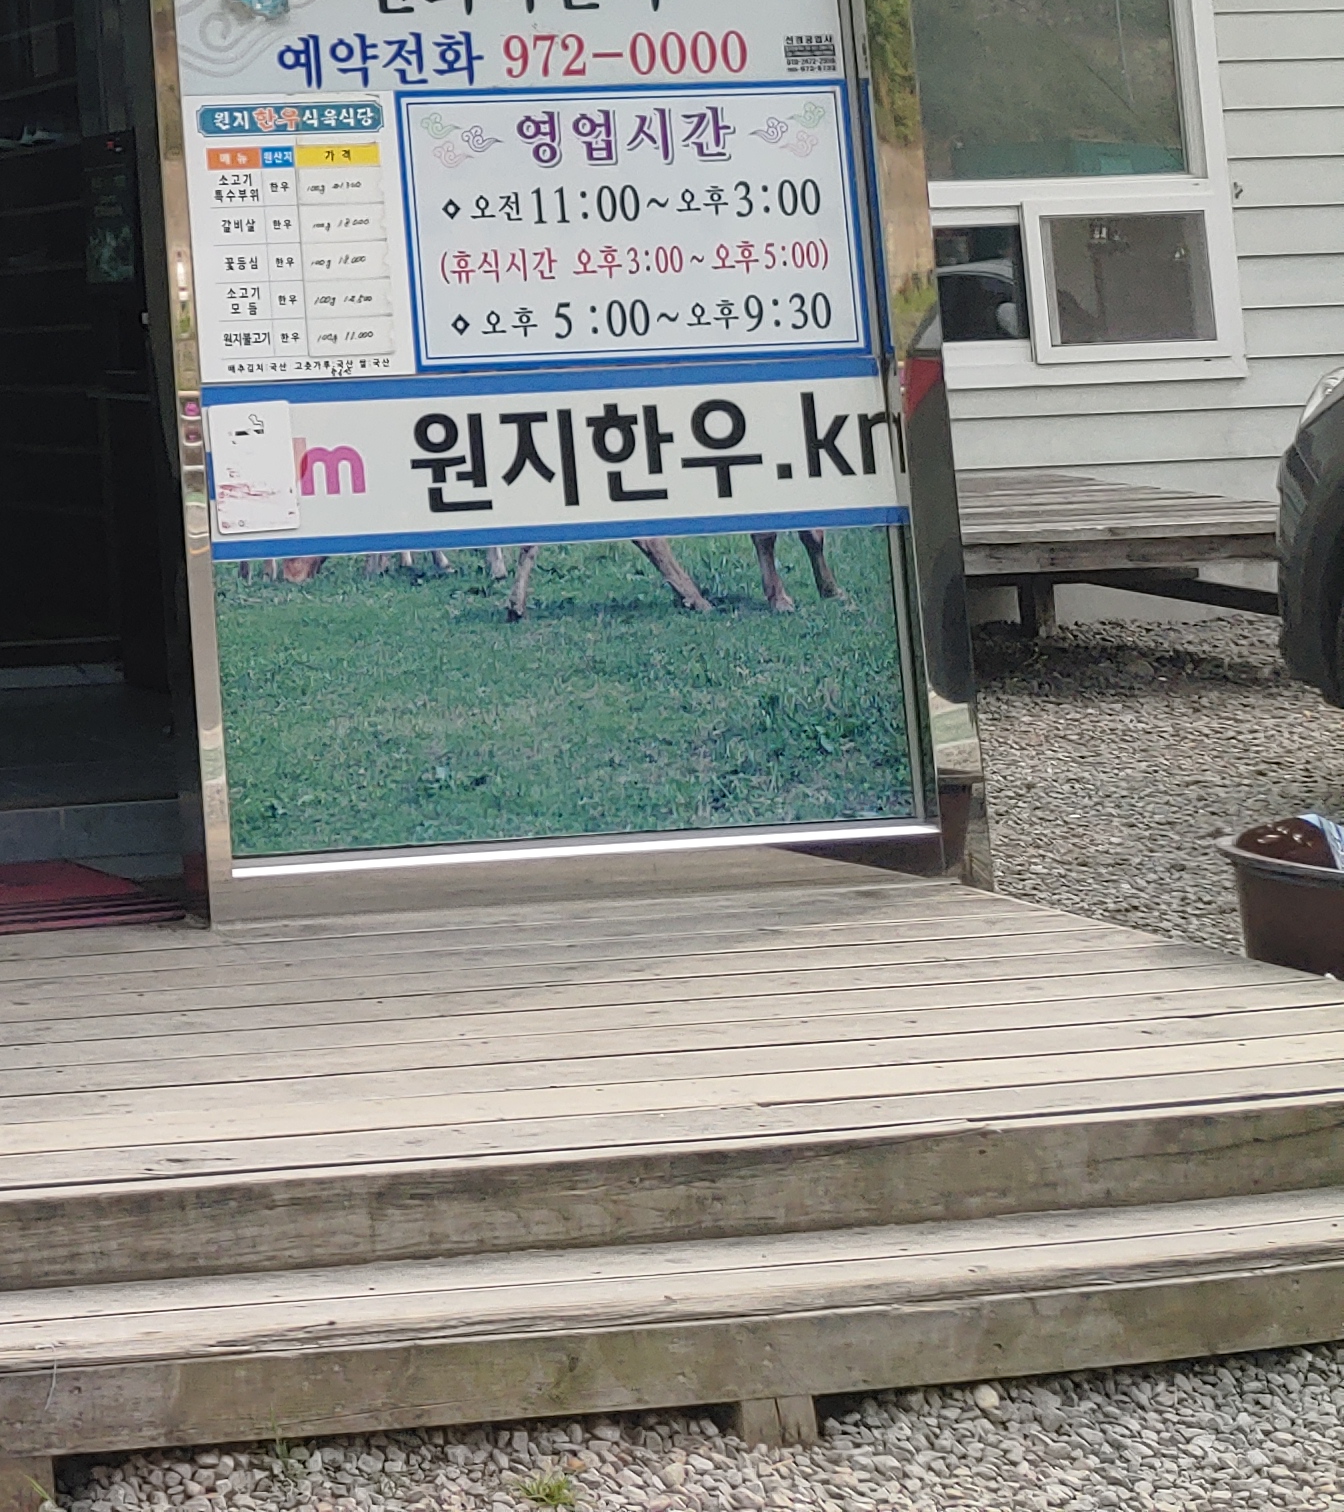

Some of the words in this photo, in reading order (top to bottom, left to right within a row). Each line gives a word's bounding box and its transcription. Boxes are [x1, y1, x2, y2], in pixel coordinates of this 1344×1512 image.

[276, 32, 484, 88] 예약전화
[502, 29, 748, 79] 972-0000
[516, 105, 736, 167] 영업시간
[264, 151, 293, 164] 원산지
[218, 173, 253, 187] 소고기
[269, 181, 290, 192] 한우
[214, 189, 260, 203] 특수부위
[221, 219, 256, 233] 갈비살
[272, 219, 293, 230] 한우
[224, 256, 259, 271] 꽃등심
[275, 257, 295, 268] 한우
[226, 287, 261, 300] 소고기
[278, 294, 298, 306] 한우
[223, 331, 271, 347] 원지불고기
[280, 332, 300, 343] 한우
